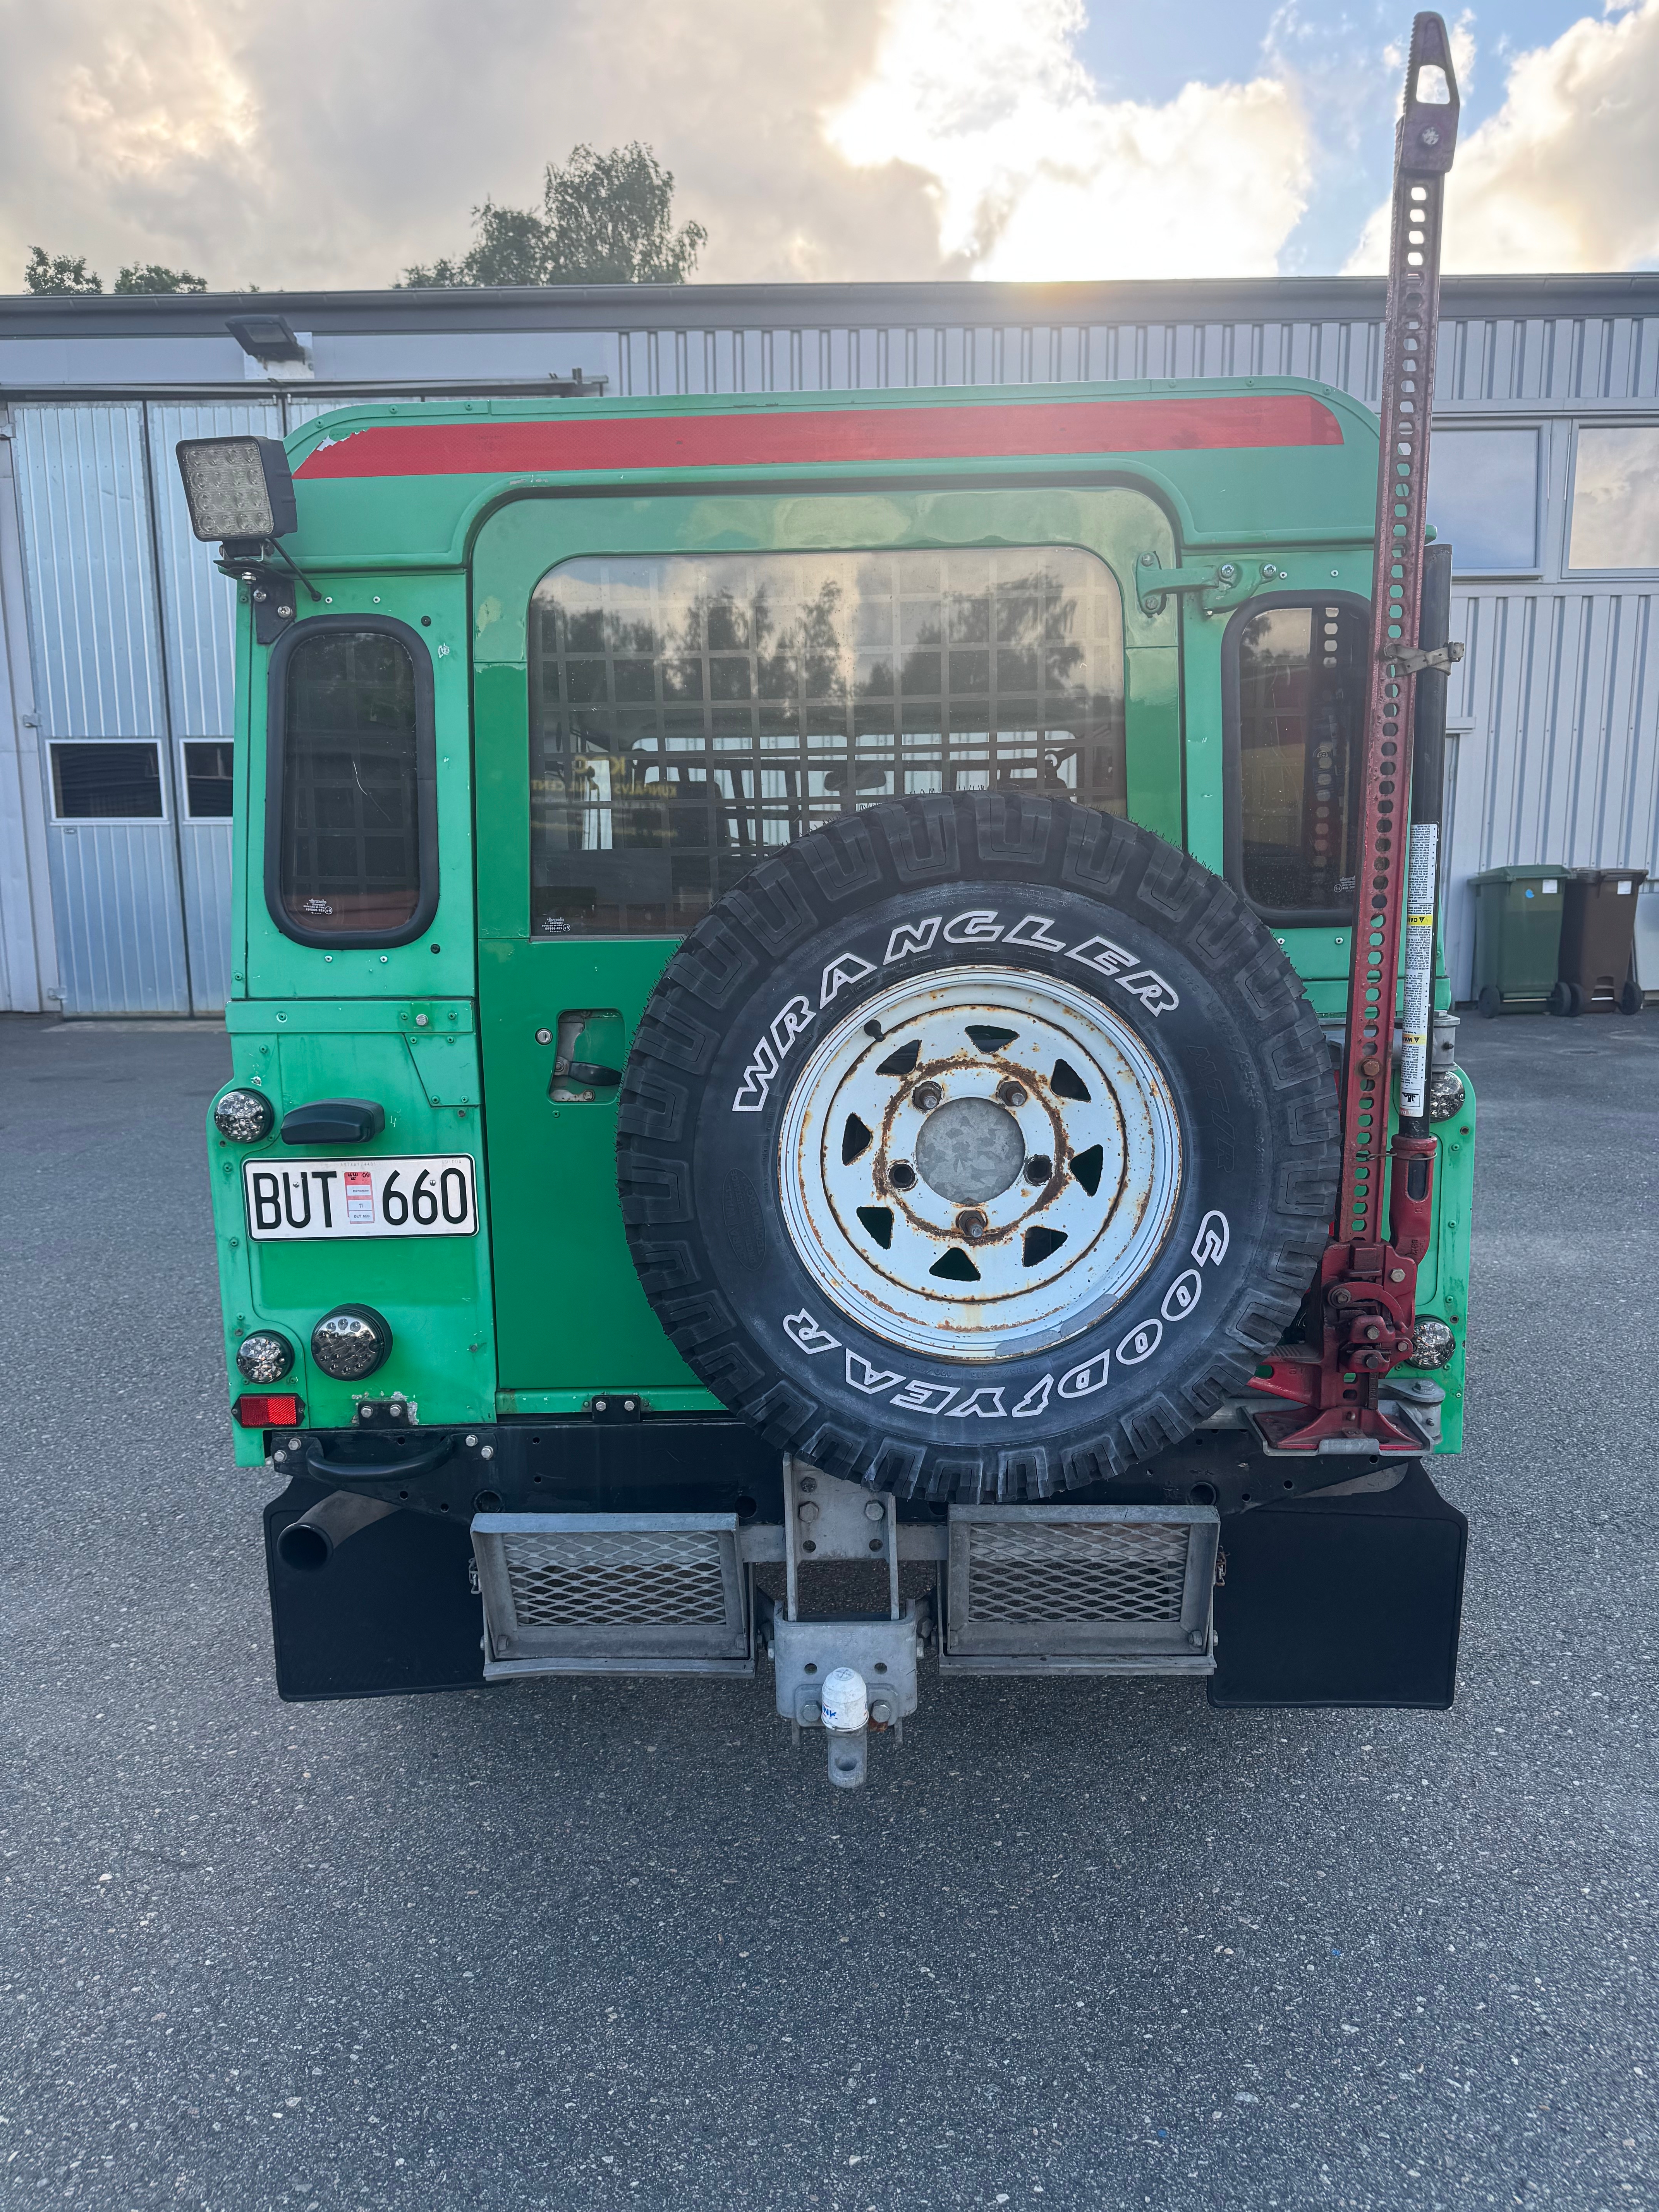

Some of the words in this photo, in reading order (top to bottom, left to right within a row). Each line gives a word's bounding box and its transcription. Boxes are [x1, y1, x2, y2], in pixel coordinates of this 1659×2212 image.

[732, 910, 1179, 1111] WRANGLER
[1187, 1046, 1235, 1173] MT/R
[252, 1170, 337, 1230] BUT
[382, 1168, 468, 1226] 660
[783, 1210, 1230, 1418] GOODYEAR
